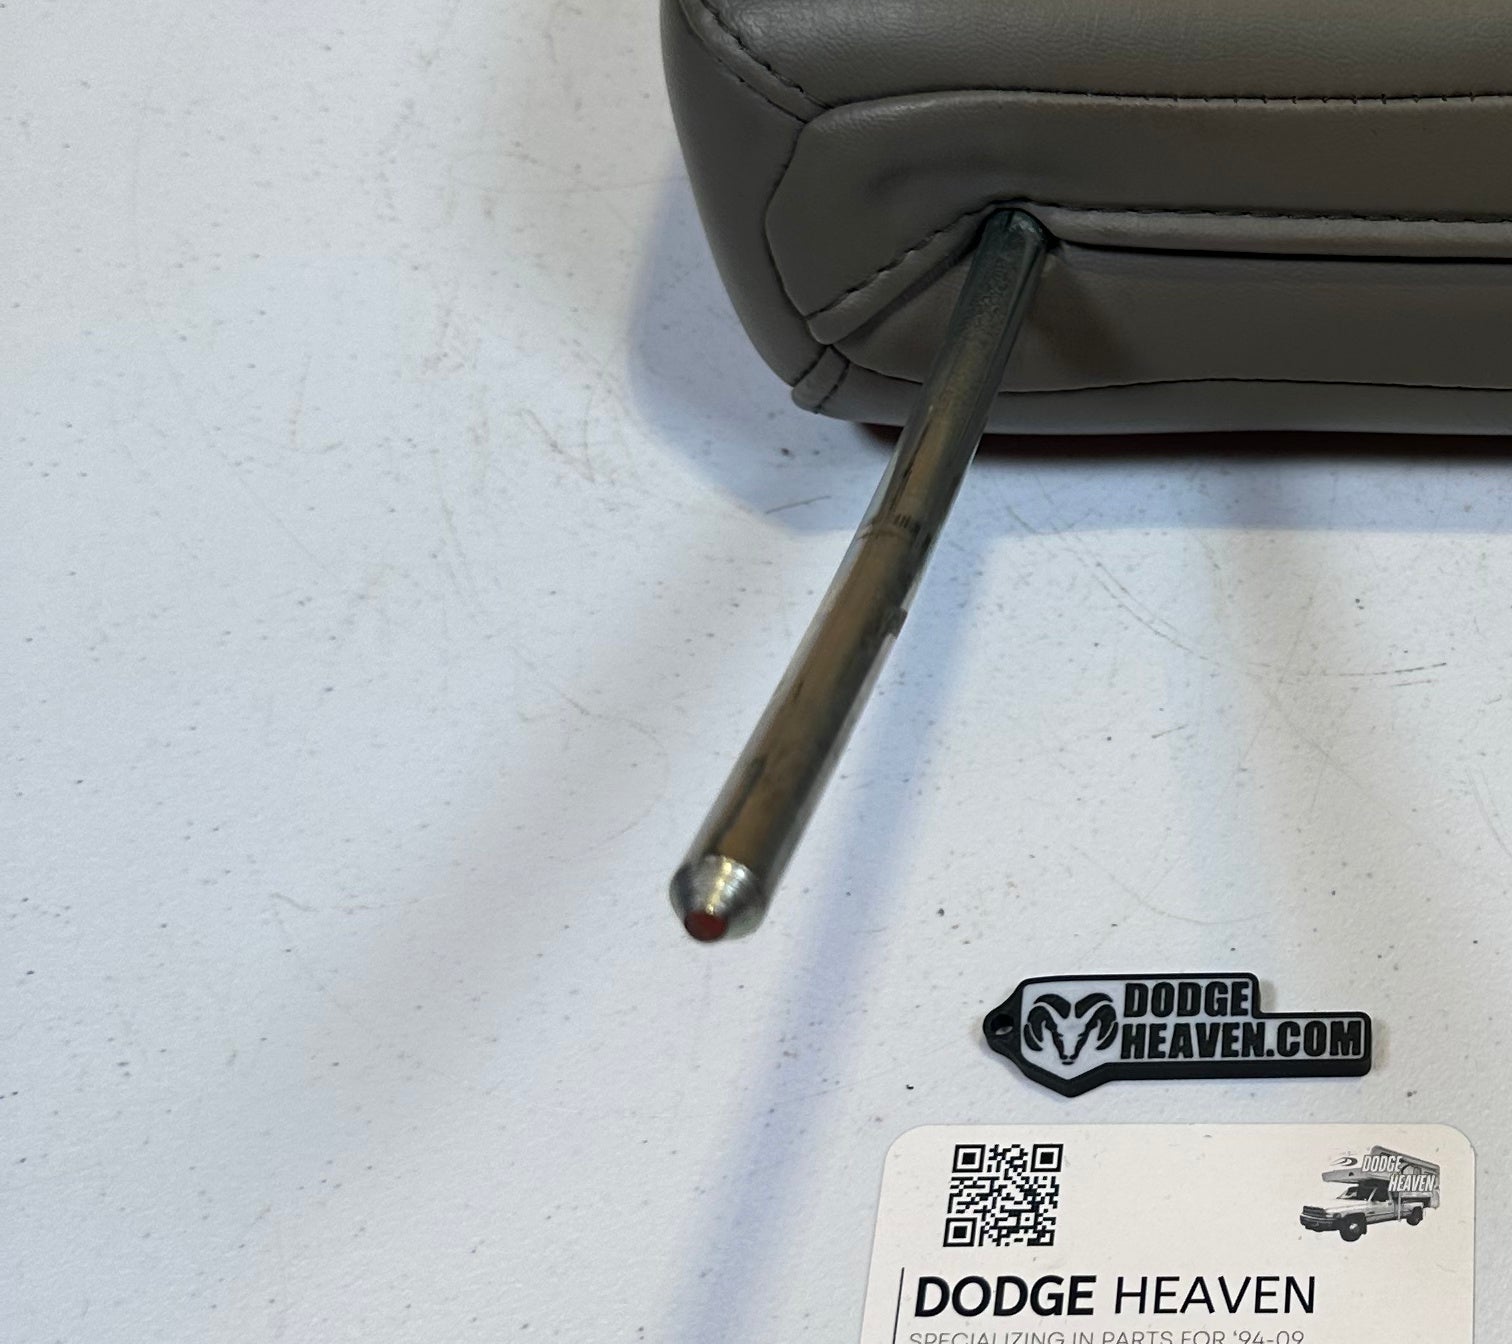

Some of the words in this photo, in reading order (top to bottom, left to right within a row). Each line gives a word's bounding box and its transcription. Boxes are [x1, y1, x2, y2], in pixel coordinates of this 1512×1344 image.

[1124, 981, 1249, 1017] DODGE
[1120, 1020, 1362, 1059] HEAVEN.COM
[1362, 1155, 1402, 1172] DODGE
[1389, 1175, 1435, 1191] HEAVEN
[915, 1275, 1096, 1317] DODGE
[1115, 1276, 1315, 1314] HEAVEN
